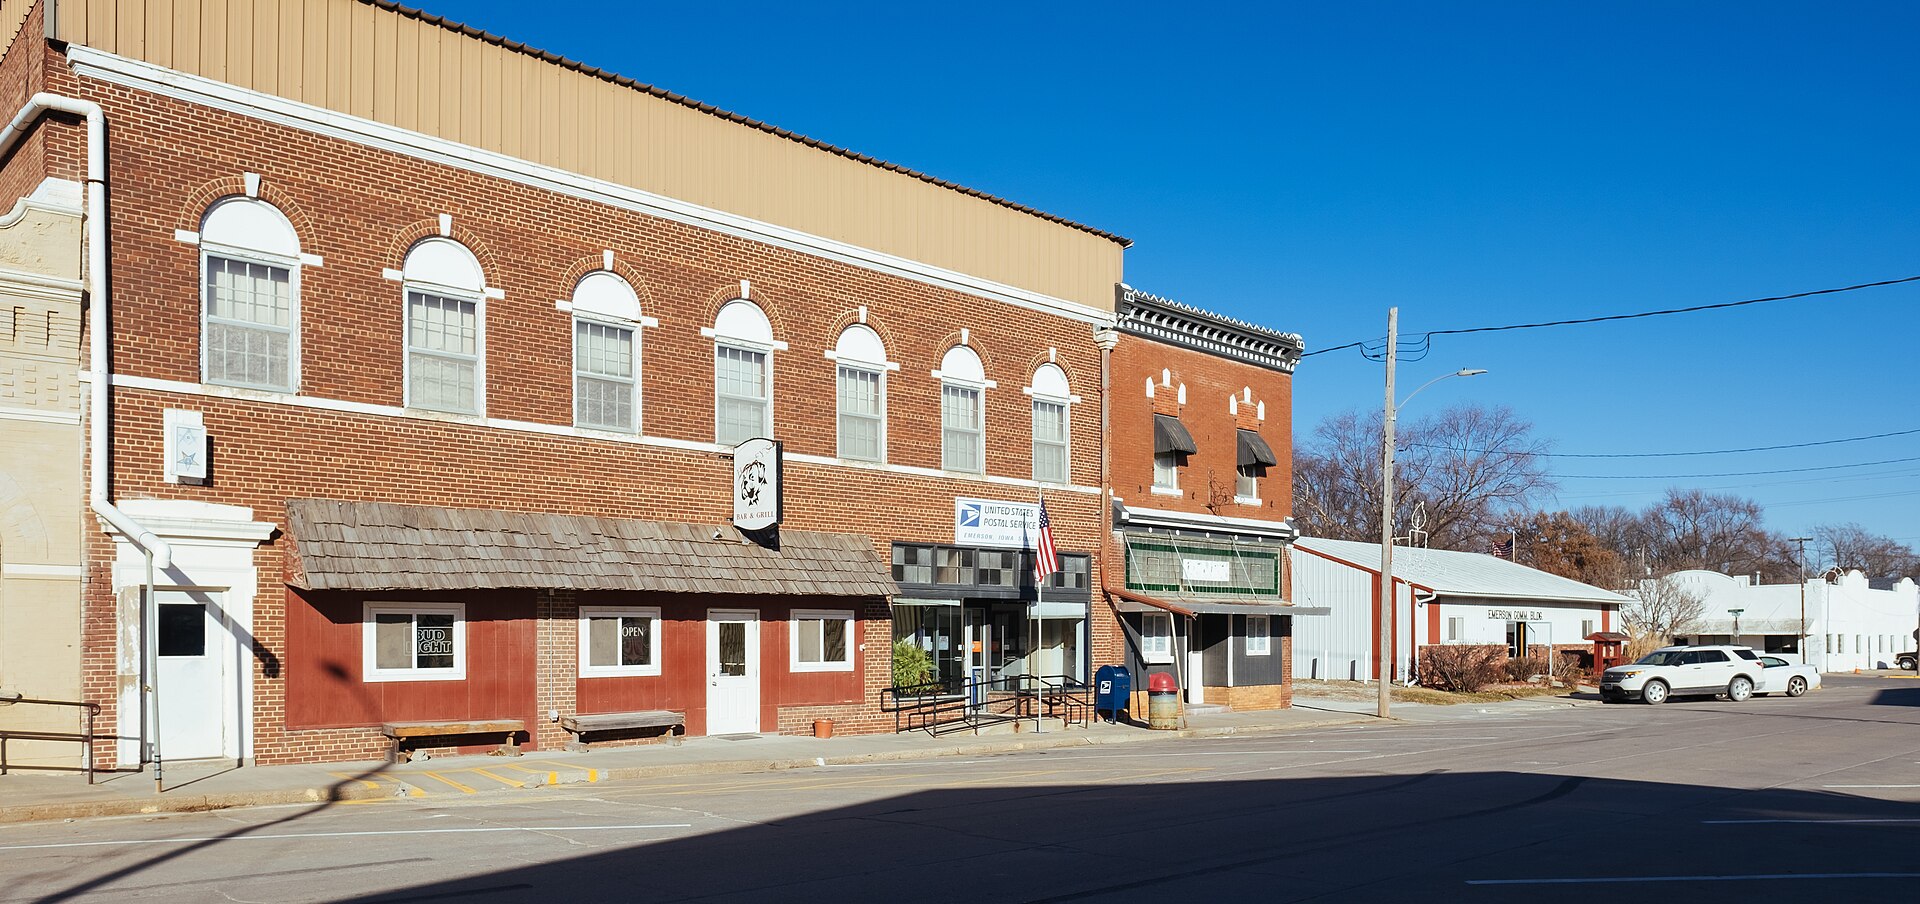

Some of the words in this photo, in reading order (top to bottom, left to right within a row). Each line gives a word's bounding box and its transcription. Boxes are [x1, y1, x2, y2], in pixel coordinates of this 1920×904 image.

[736, 512, 747, 520] BAR
[756, 510, 774, 519] GRILL
[984, 505, 1010, 516] UNITED
[1011, 507, 1034, 518] STATES
[984, 517, 1008, 528] POSTAL
[1010, 519, 1036, 530] SERVICE
[1488, 609, 1512, 620] EMERSON
[417, 629, 446, 641] BUD
[622, 626, 644, 637] OPEN
